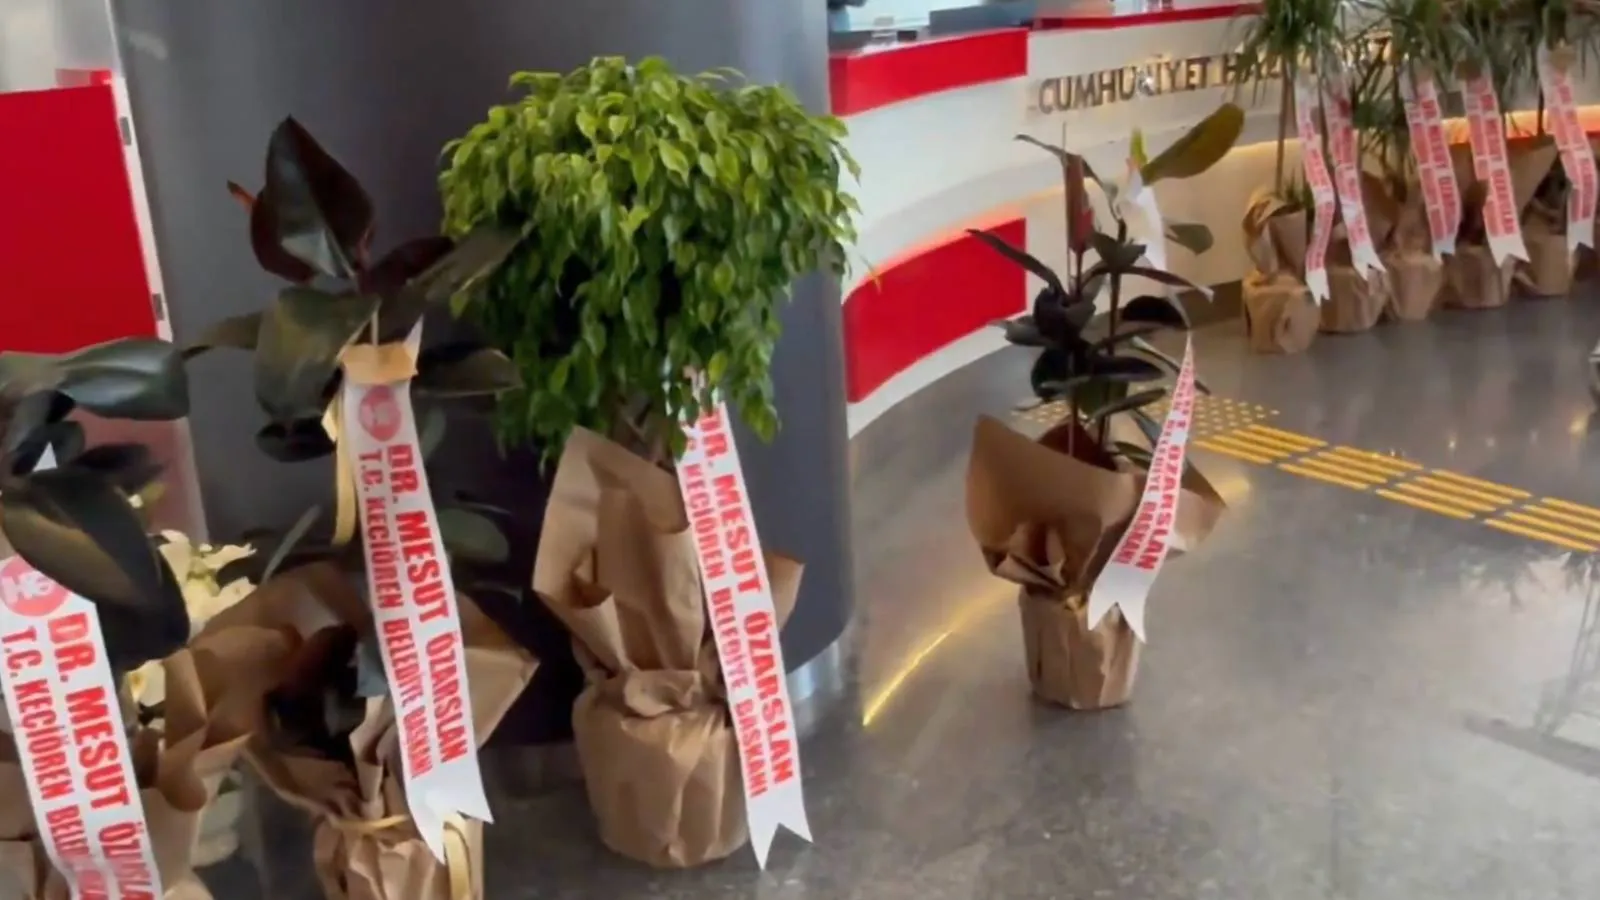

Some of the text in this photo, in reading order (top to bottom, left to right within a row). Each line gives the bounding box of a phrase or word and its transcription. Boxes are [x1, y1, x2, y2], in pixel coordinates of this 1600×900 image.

[358, 449, 384, 491] T.C.
[382, 617, 426, 708] BELEDİYE
[387, 443, 467, 763] DR. MESUT ÖZARSLAN
[711, 586, 748, 692] BELEDİYE
[712, 473, 763, 594] MESUT
[743, 609, 794, 784] ÖZARSLAN
[2, 625, 43, 678] T.C.
[47, 611, 96, 682] DR.
[65, 685, 131, 810] MESUT
